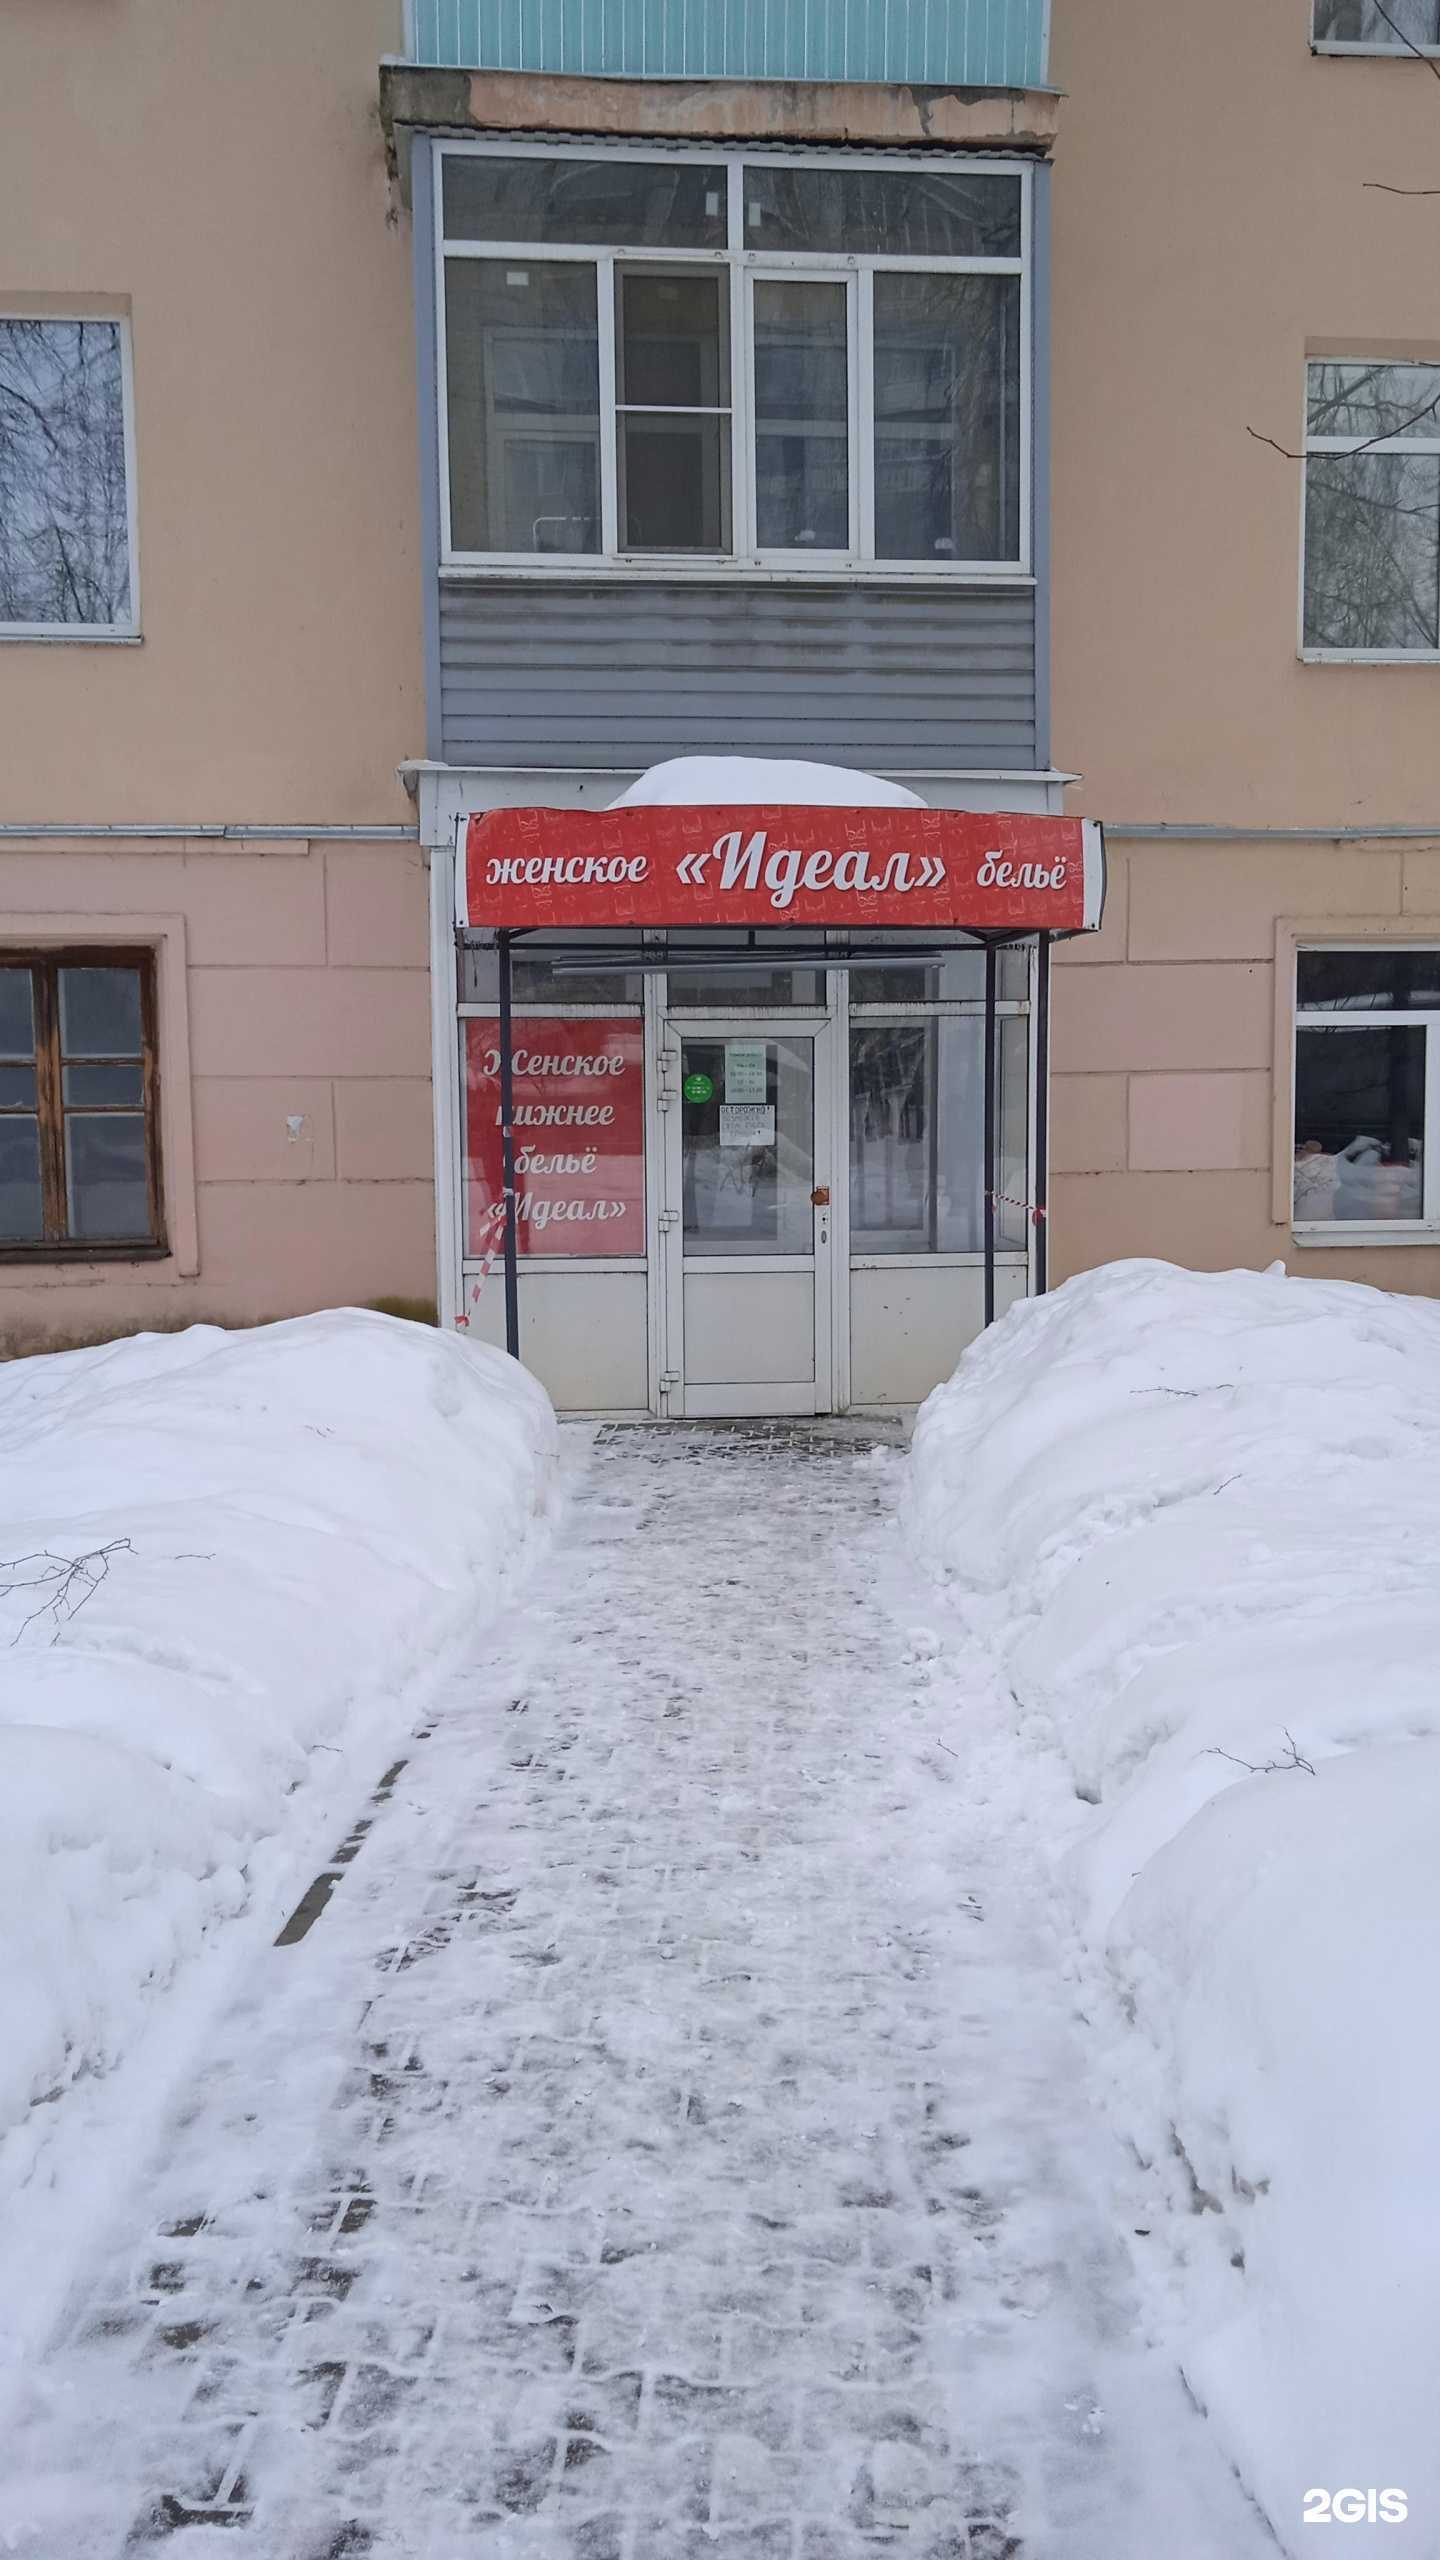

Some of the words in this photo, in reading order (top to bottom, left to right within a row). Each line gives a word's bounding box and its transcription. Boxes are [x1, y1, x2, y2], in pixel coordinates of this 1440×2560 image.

[485, 855, 649, 885] женское
[675, 831, 946, 908] «Идеал»
[976, 850, 1067, 890] бельё
[514, 1144, 598, 1174] бельё
